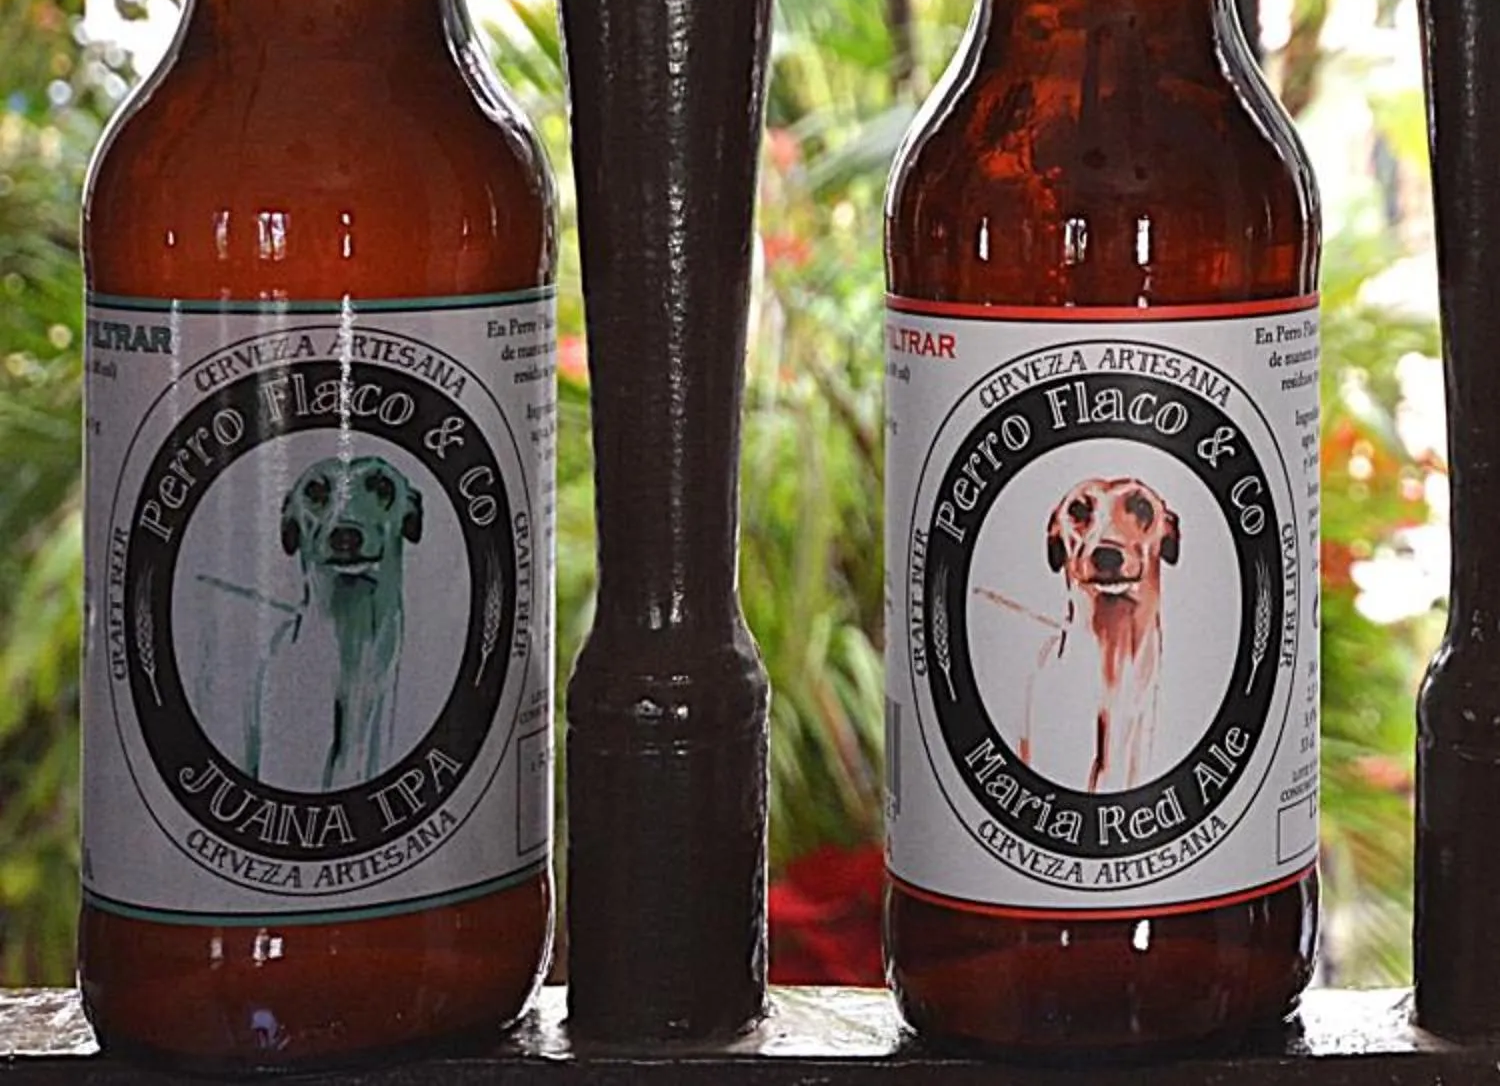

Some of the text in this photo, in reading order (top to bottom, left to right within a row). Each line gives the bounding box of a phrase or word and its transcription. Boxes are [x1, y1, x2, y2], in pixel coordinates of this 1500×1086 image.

[89, 319, 172, 354] LTRAR
[328, 334, 467, 399] ARTESANA
[887, 325, 957, 359] LTRAR
[1100, 347, 1233, 408] ARTESANA
[139, 372, 497, 544] Perro Flaco & Co
[935, 414, 1031, 544] Perro
[1043, 381, 1189, 434] Flaco
[1197, 425, 1237, 469] &
[1231, 475, 1265, 535] Co
[178, 748, 463, 848] JUANA IPA
[1098, 785, 1187, 846] Red
[1192, 726, 1249, 806] Ale
[313, 810, 457, 889] ARTESANA
[1094, 815, 1228, 884] ARTESANA
